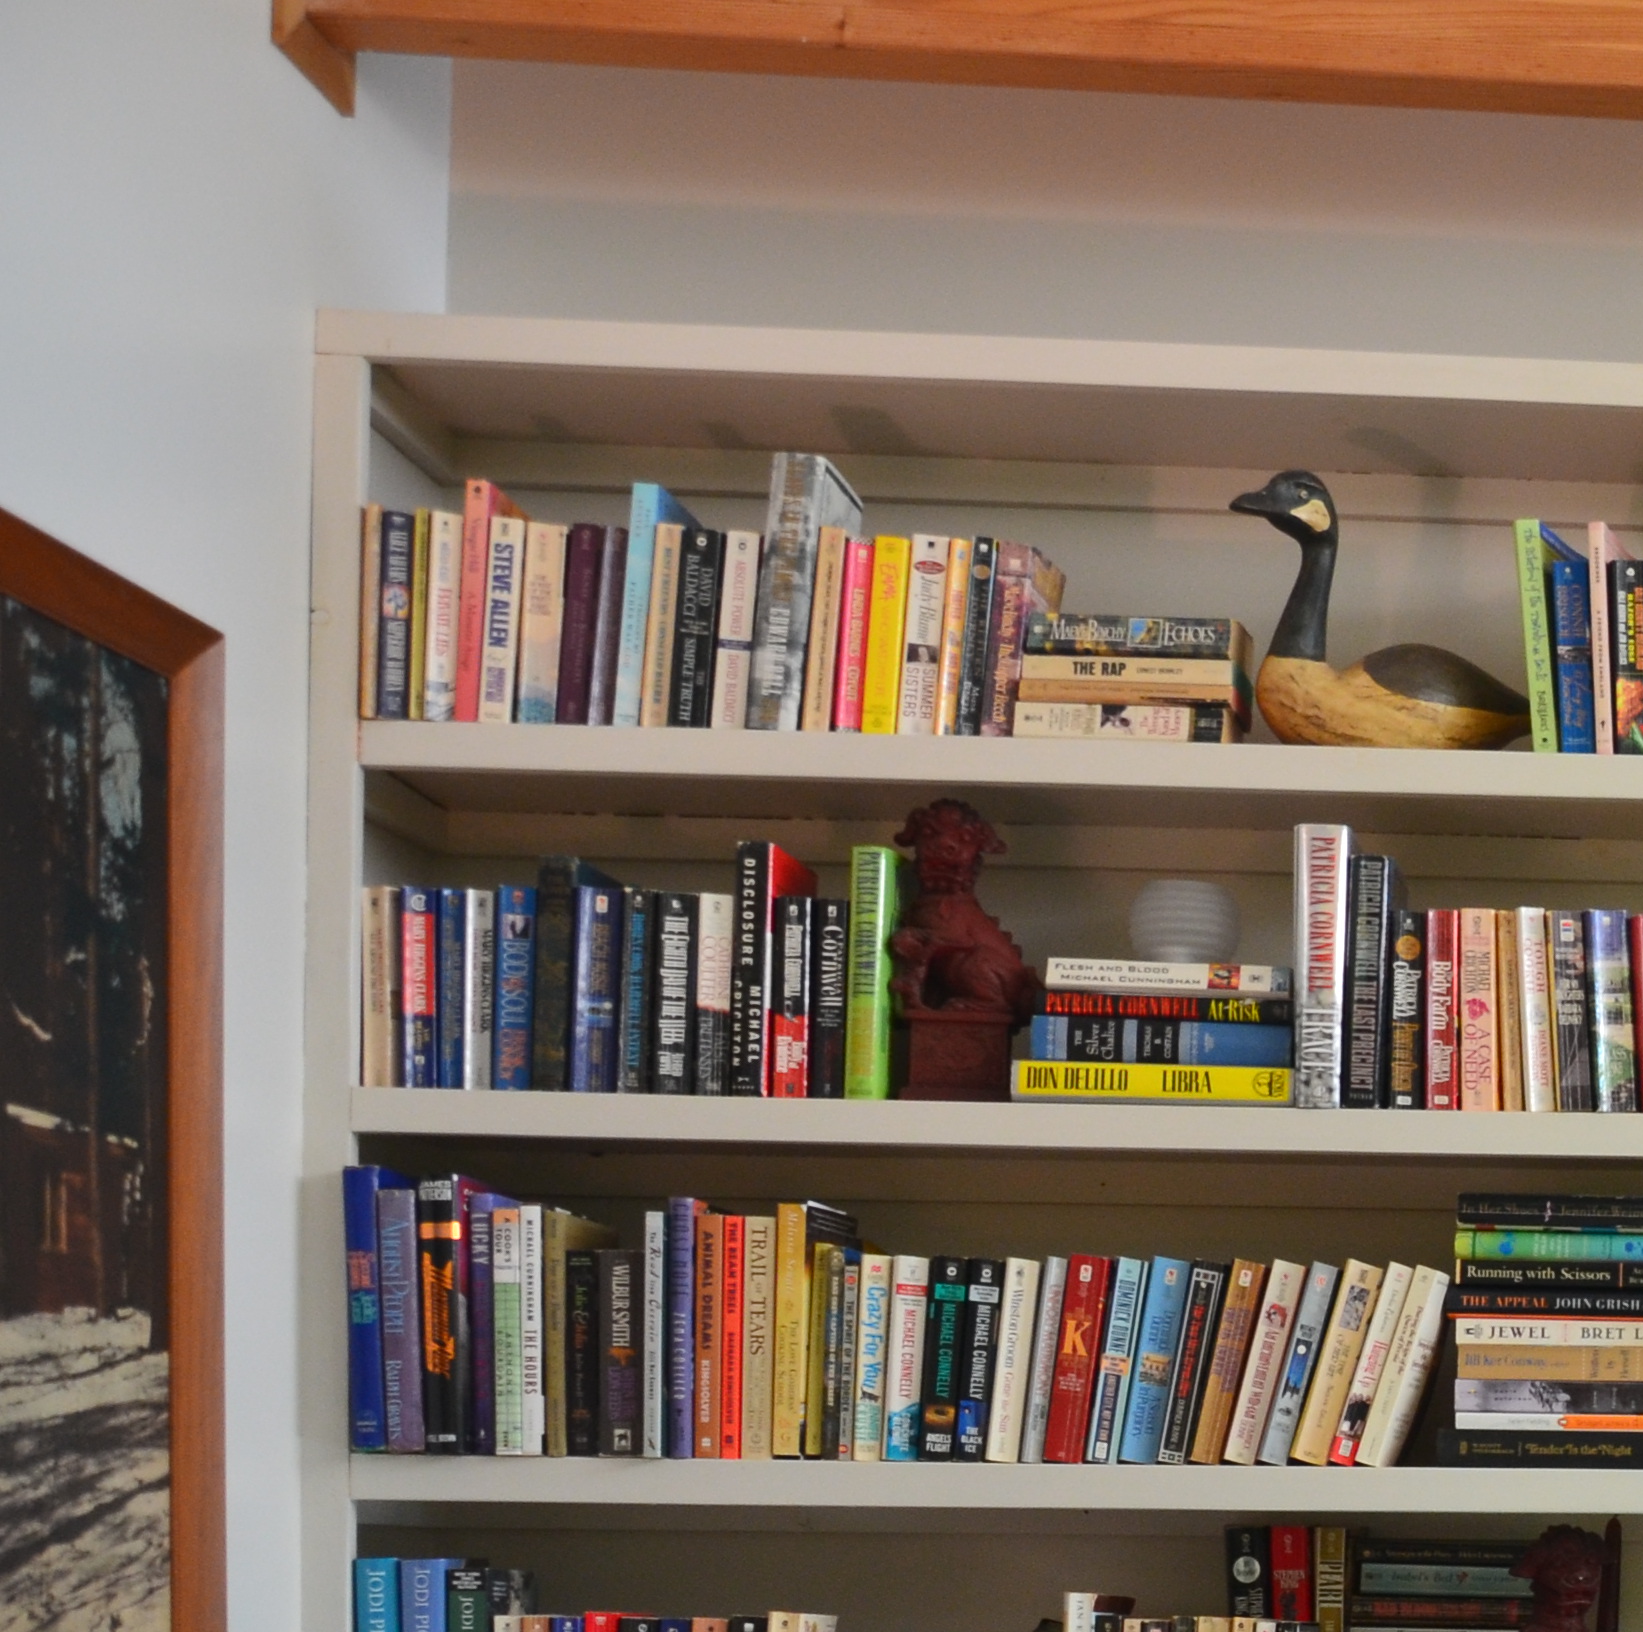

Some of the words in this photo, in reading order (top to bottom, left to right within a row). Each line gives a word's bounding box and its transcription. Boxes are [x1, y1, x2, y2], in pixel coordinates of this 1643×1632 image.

[492, 544, 513, 593] STEVE
[683, 554, 699, 616] BALDACCI
[698, 567, 713, 607] DAVID
[489, 598, 508, 647] ALLEN
[682, 638, 697, 677] SIMPLE
[680, 680, 694, 721] TRUTH
[857, 852, 876, 913] PATRICIA
[1309, 837, 1335, 905] PATRICIA
[740, 859, 757, 965] DISCLOSURE
[852, 922, 876, 998] CORNWELL
[1308, 913, 1336, 991] CORNWELL
[1301, 1009, 1337, 1074] TRACE
[1027, 1066, 1056, 1089] DON
[1064, 1068, 1128, 1091] DELILLO
[1162, 1069, 1212, 1092] LIBRA
[700, 1232, 713, 1288] ANIMAL
[1467, 1266, 1521, 1282] Running
[1526, 1267, 1554, 1281] with
[1560, 1267, 1610, 1282] Scissors
[701, 1294, 713, 1350] DREAMS
[1461, 1295, 1487, 1307] THE
[1493, 1296, 1548, 1308] APPEAL
[1554, 1297, 1593, 1310] JOHN
[367, 1569, 385, 1610] JODI
